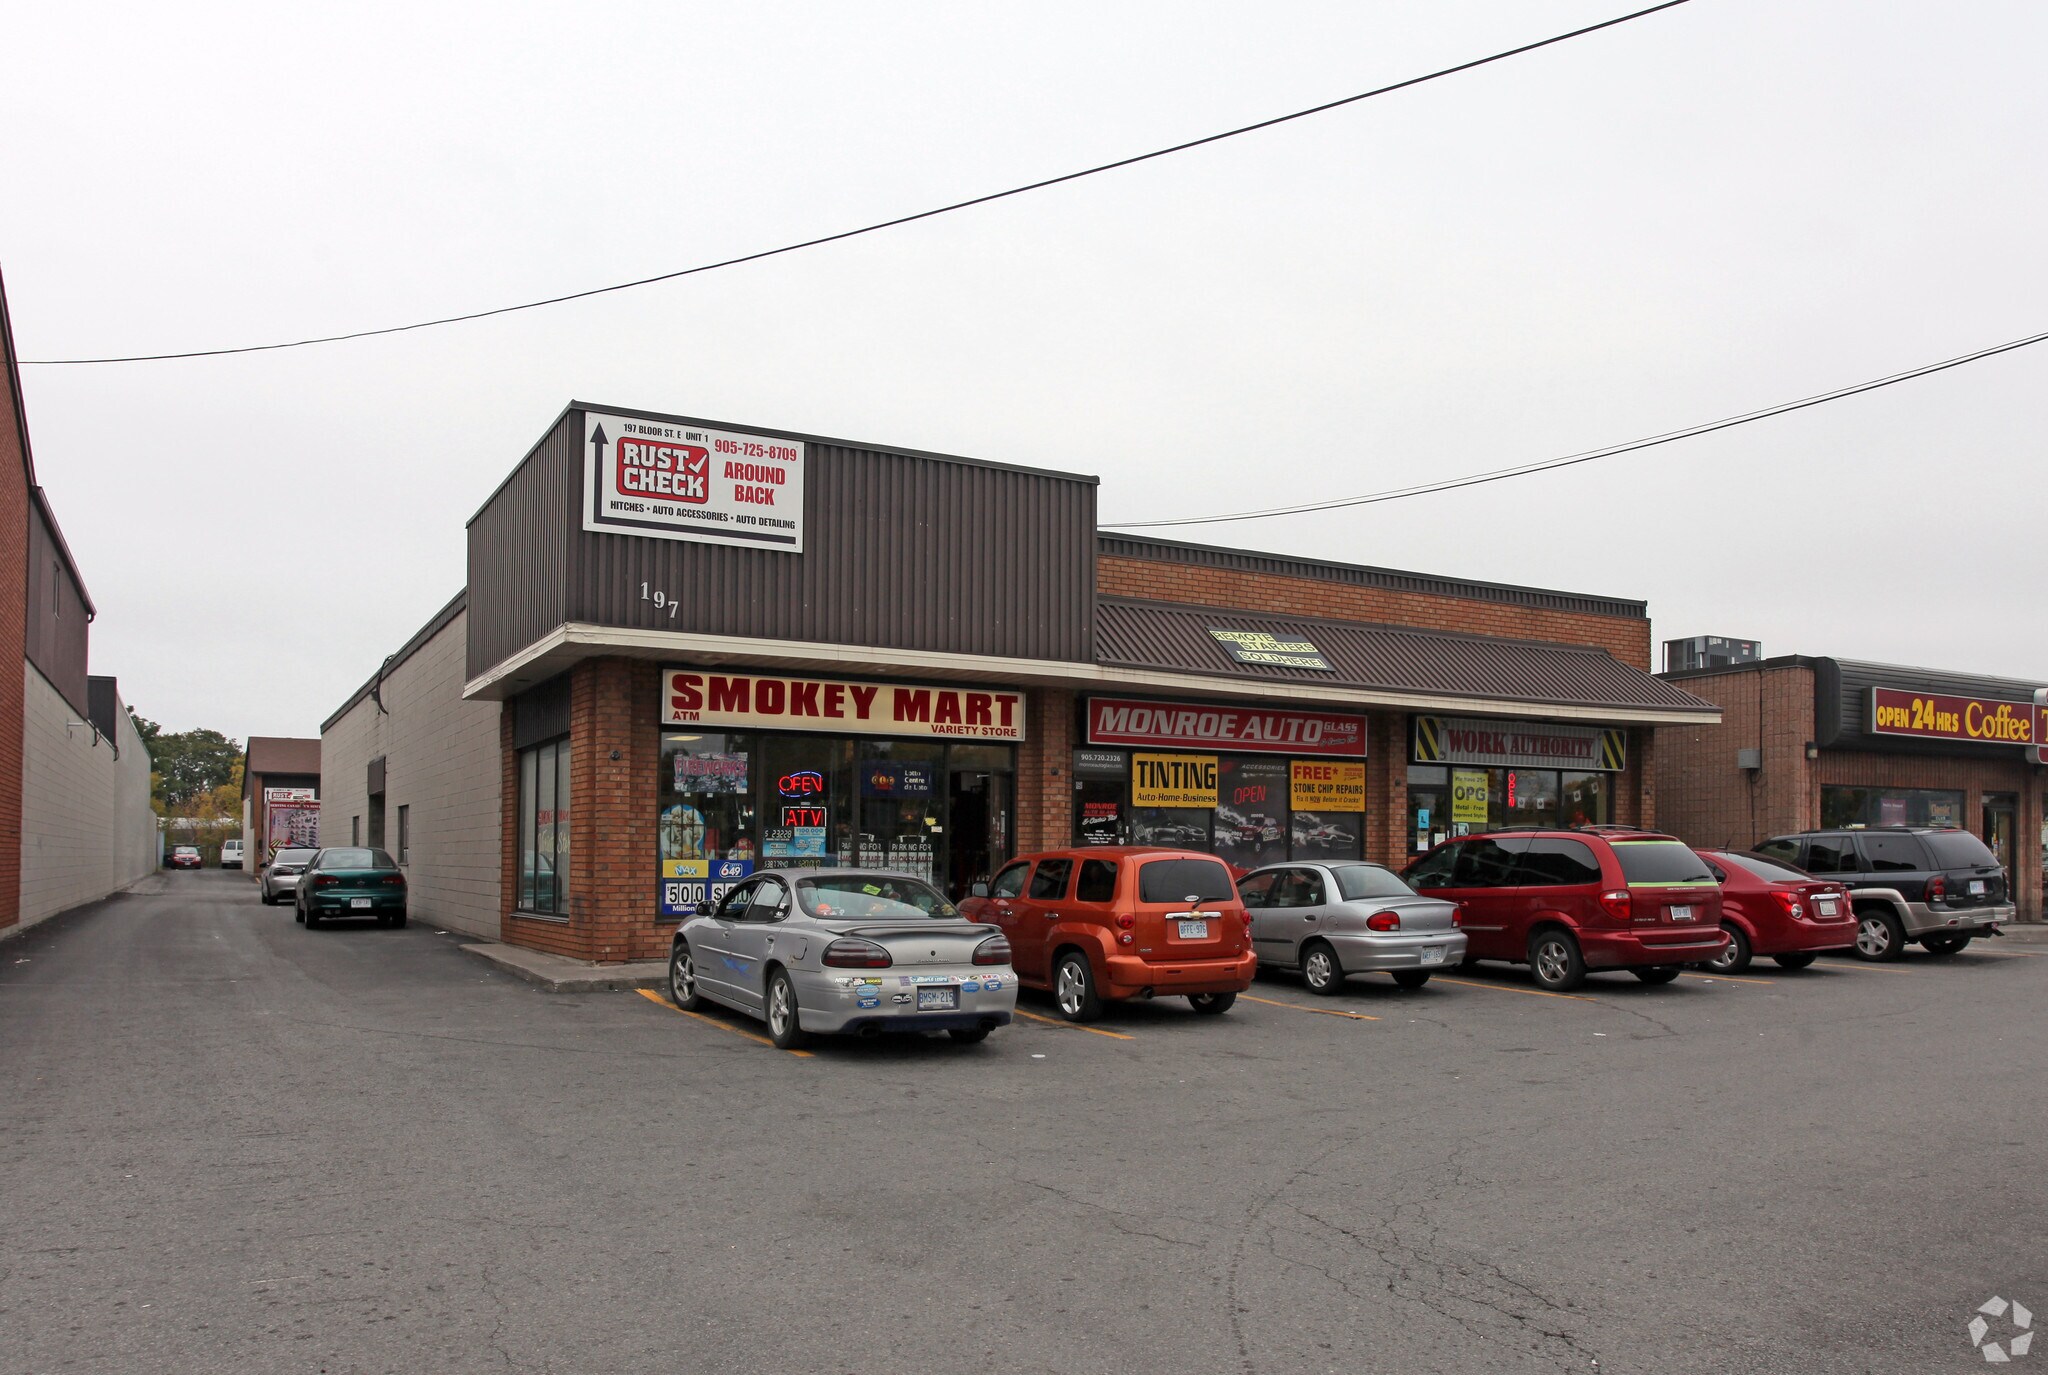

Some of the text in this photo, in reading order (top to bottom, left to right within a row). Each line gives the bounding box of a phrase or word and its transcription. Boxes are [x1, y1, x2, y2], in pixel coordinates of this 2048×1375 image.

[624, 424, 636, 433] 197
[639, 426, 662, 436] BLOOR
[665, 429, 675, 438] ST.
[677, 431, 681, 439] E
[686, 432, 702, 441] UNIT
[623, 442, 689, 472] RUST
[715, 439, 797, 461] 905-725-8709
[623, 467, 704, 498] CHECK
[724, 461, 785, 485] AROUND
[735, 484, 774, 506] BACK
[611, 500, 795, 529] HITCHES AUTO ACCESSORIES AUTO DETAILING
[641, 581, 679, 618] 197
[1211, 631, 1273, 642] REMOTE
[1240, 642, 1317, 652] STARTERS
[671, 673, 1018, 727] SMOKEY MART
[672, 711, 700, 721] ATM
[1098, 707, 1325, 743] MONROE AUTO
[1324, 721, 1358, 731] GLASS
[1877, 706, 1909, 728] OPEN
[1912, 698, 1935, 730] 24
[1936, 713, 1959, 733] HRS
[1965, 702, 2031, 741] Coffee
[931, 724, 1017, 737] VARIETY STORE
[1448, 729, 1594, 757] WORK AUTHORITY
[676, 759, 747, 777] FIREWORKS
[1081, 753, 1120, 761] 905.720.2326
[778, 775, 823, 792] OPEN
[1137, 761, 1216, 789] TINTING
[1233, 785, 1266, 805] OPEN
[1294, 783, 1363, 795] STONE CHIP REPAIRS
[1455, 785, 1486, 801] OPG
[1507, 773, 1516, 807] OPEN
